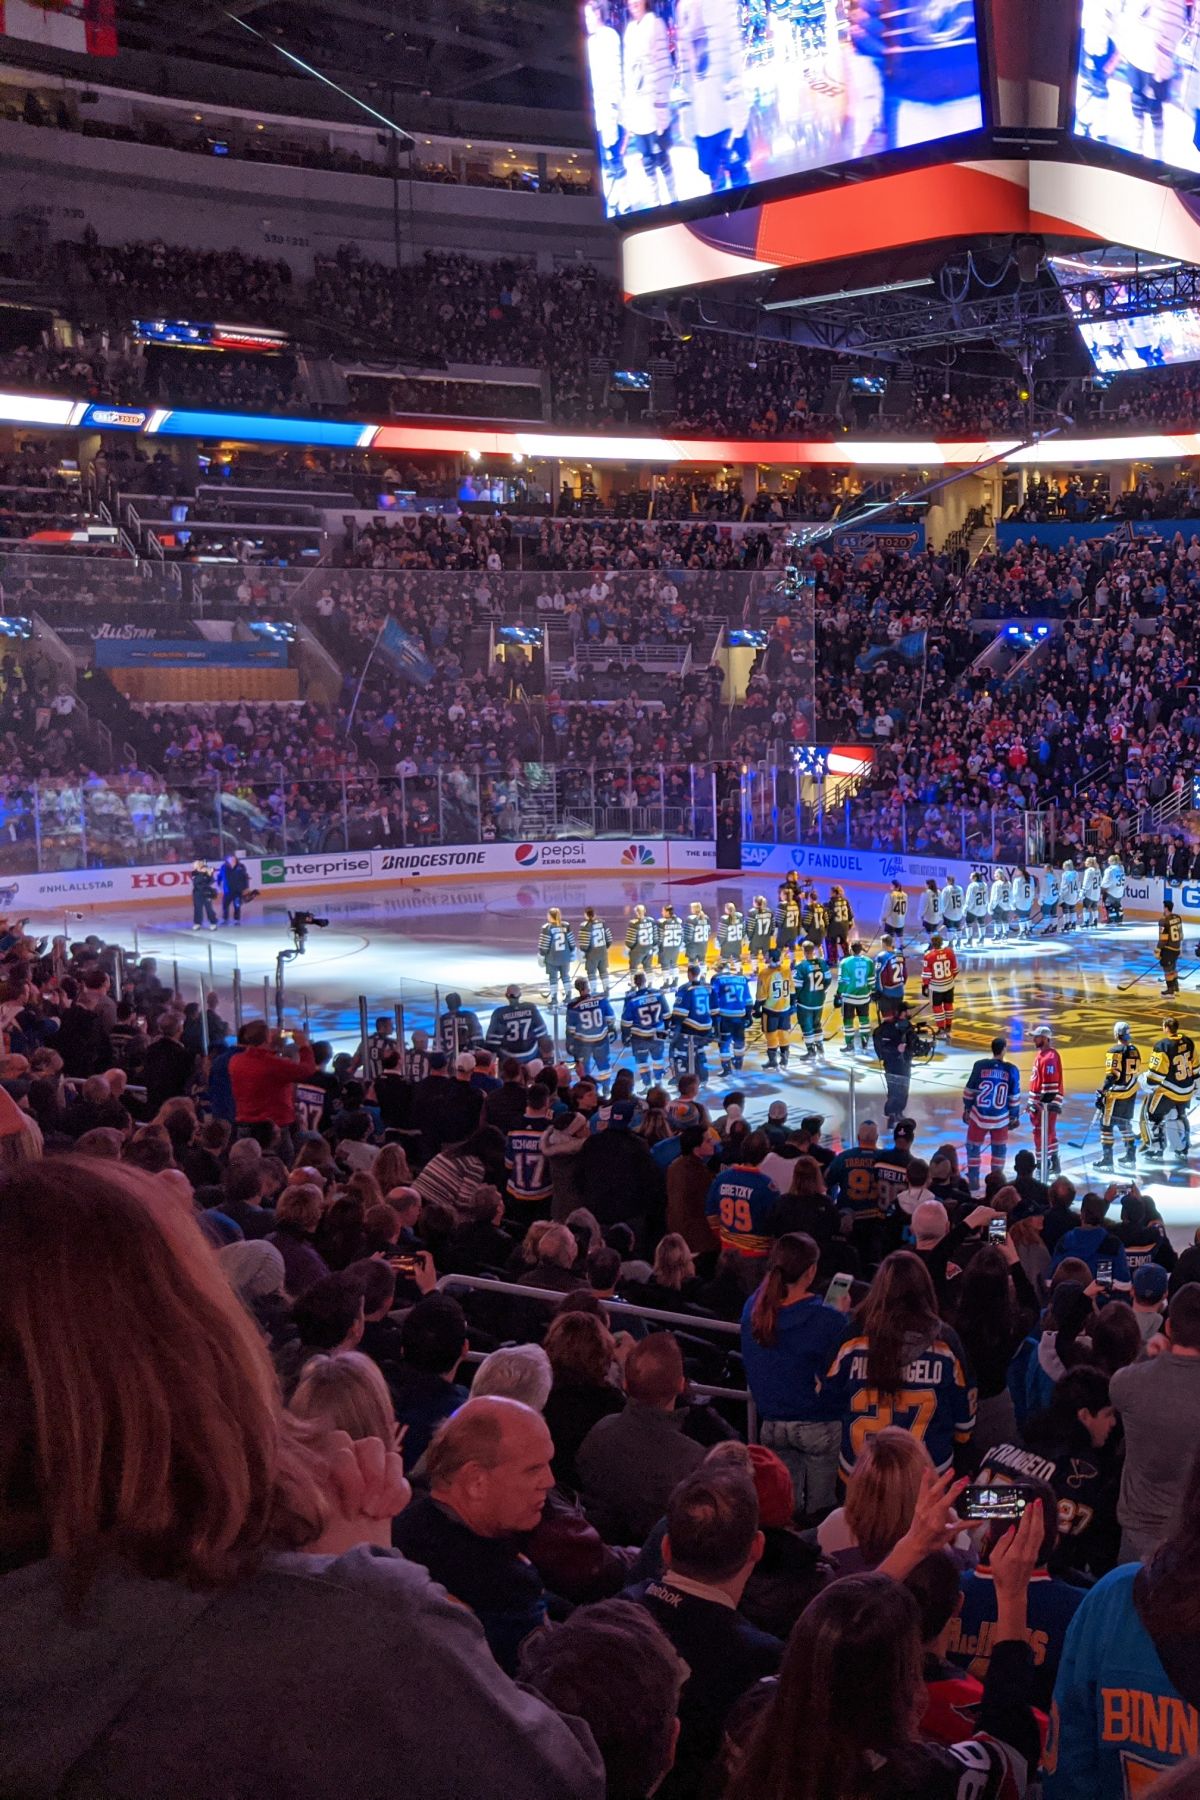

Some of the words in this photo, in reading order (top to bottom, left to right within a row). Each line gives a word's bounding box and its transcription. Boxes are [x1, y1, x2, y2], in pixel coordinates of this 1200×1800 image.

[878, 538, 907, 547] 2020
[541, 843, 584, 858] pepsi
[742, 848, 768, 866] SAP
[262, 858, 370, 878] enterprise
[382, 851, 487, 870] BRIDGESTONE
[808, 852, 863, 871] FANDUEL
[970, 863, 1017, 883] TRUY
[39, 880, 114, 894] #NHLALLSTAR
[757, 918, 771, 936] 17
[554, 932, 566, 951] 2
[662, 929, 682, 948] 25
[932, 961, 951, 979] 88
[771, 979, 790, 999] 59
[808, 972, 824, 991] 12
[725, 985, 744, 1003] 27
[579, 1008, 603, 1030] 90
[637, 1003, 662, 1026] 57
[506, 1018, 532, 1042] 37
[1174, 1053, 1193, 1079] 35
[976, 1082, 1009, 1108] 20
[512, 1138, 542, 1150] SCHWART
[513, 1154, 545, 1189] 17
[844, 1158, 875, 1168] TARASE
[719, 1183, 754, 1201] GRETZKY
[719, 1197, 753, 1233] 99
[850, 1387, 938, 1455] 27
